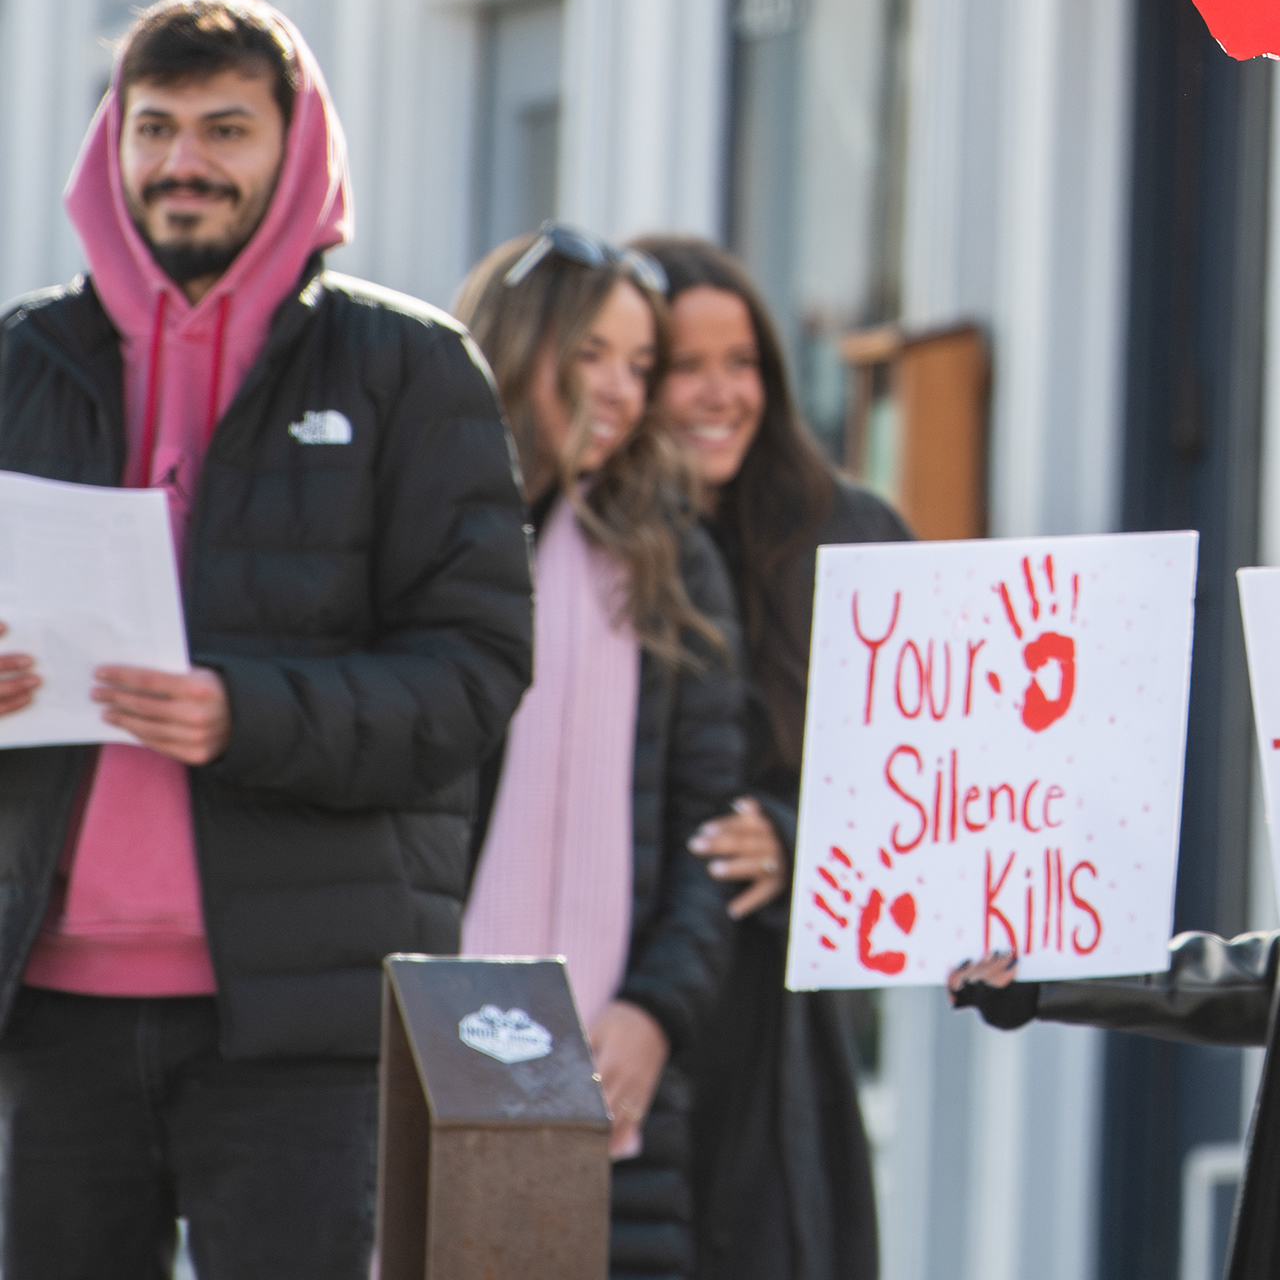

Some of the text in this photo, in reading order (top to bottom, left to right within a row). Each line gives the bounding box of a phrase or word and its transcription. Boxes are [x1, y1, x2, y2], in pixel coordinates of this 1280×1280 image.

[851, 589, 986, 725] Your
[884, 743, 1065, 854] Silence
[983, 847, 1103, 960] Kills
